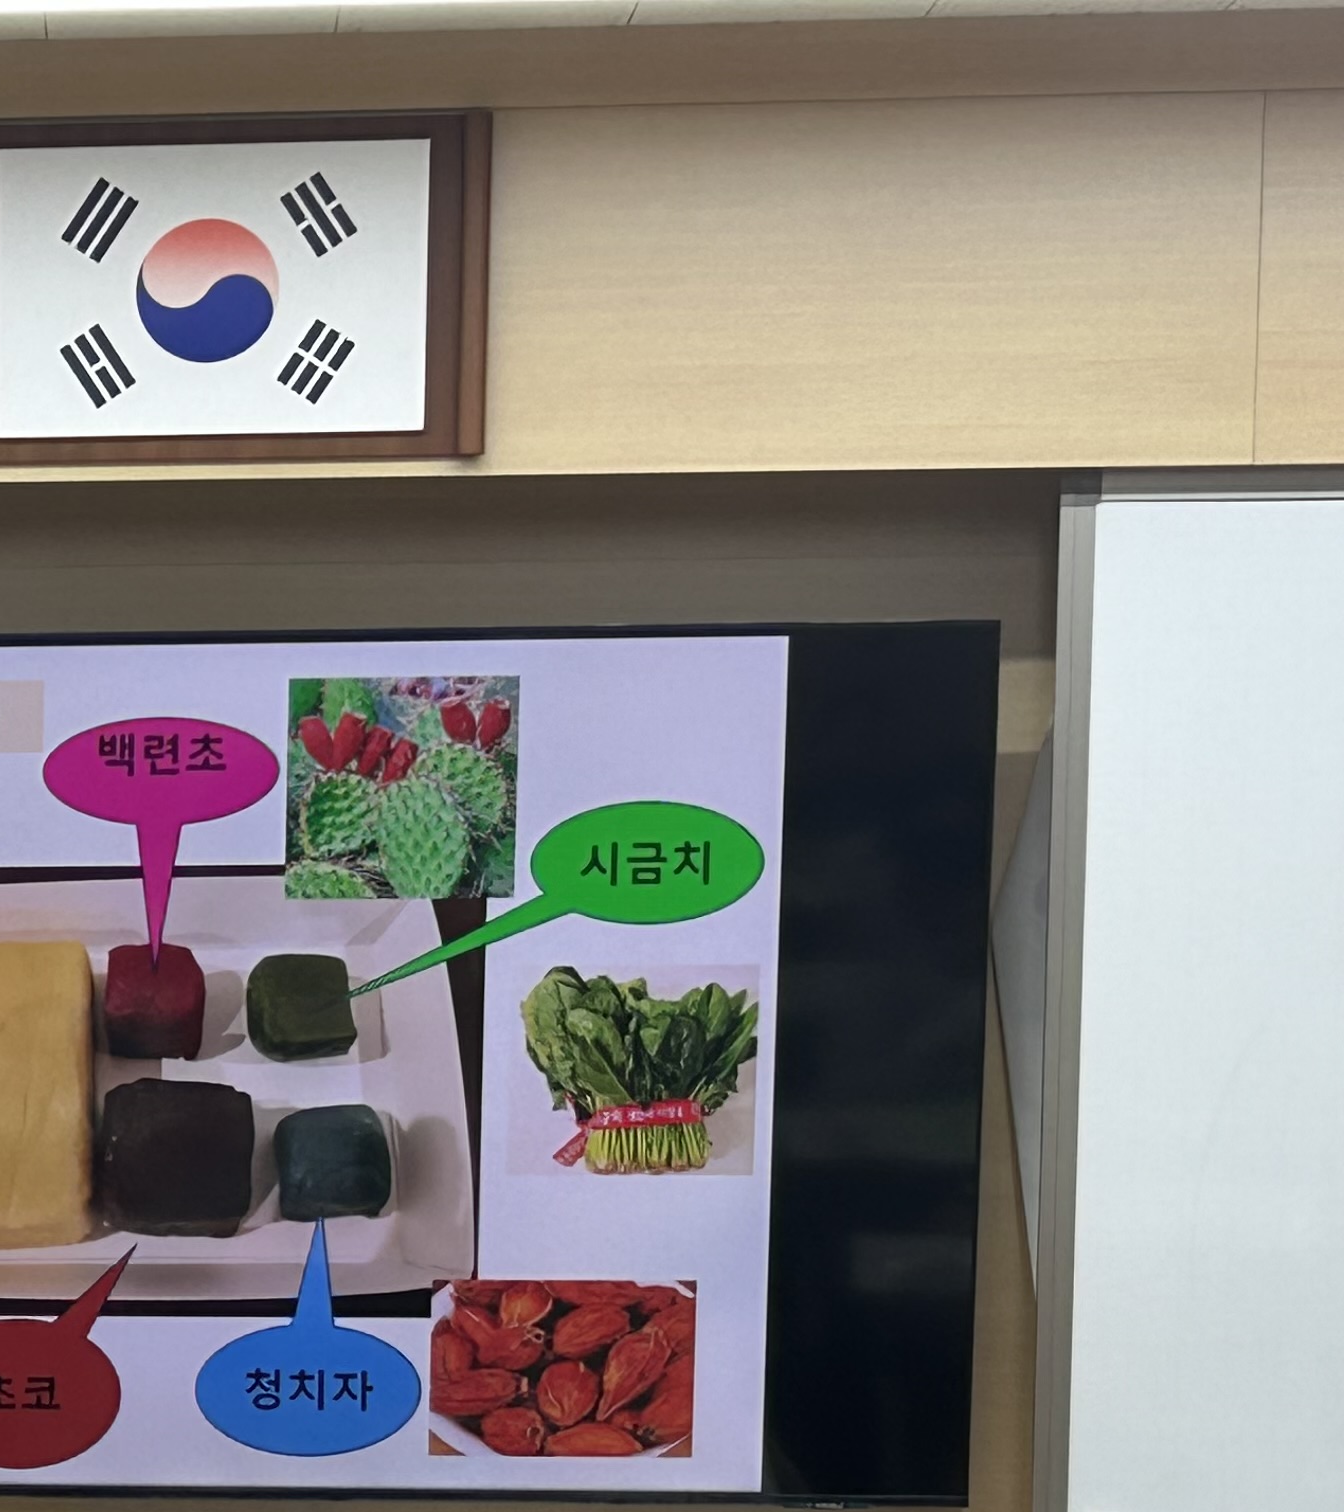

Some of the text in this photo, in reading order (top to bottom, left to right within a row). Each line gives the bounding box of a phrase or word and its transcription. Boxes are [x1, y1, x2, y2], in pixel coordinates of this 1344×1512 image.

[98, 733, 227, 777] 백련초
[580, 840, 711, 887] 시금치
[244, 1367, 375, 1412] 청치자
